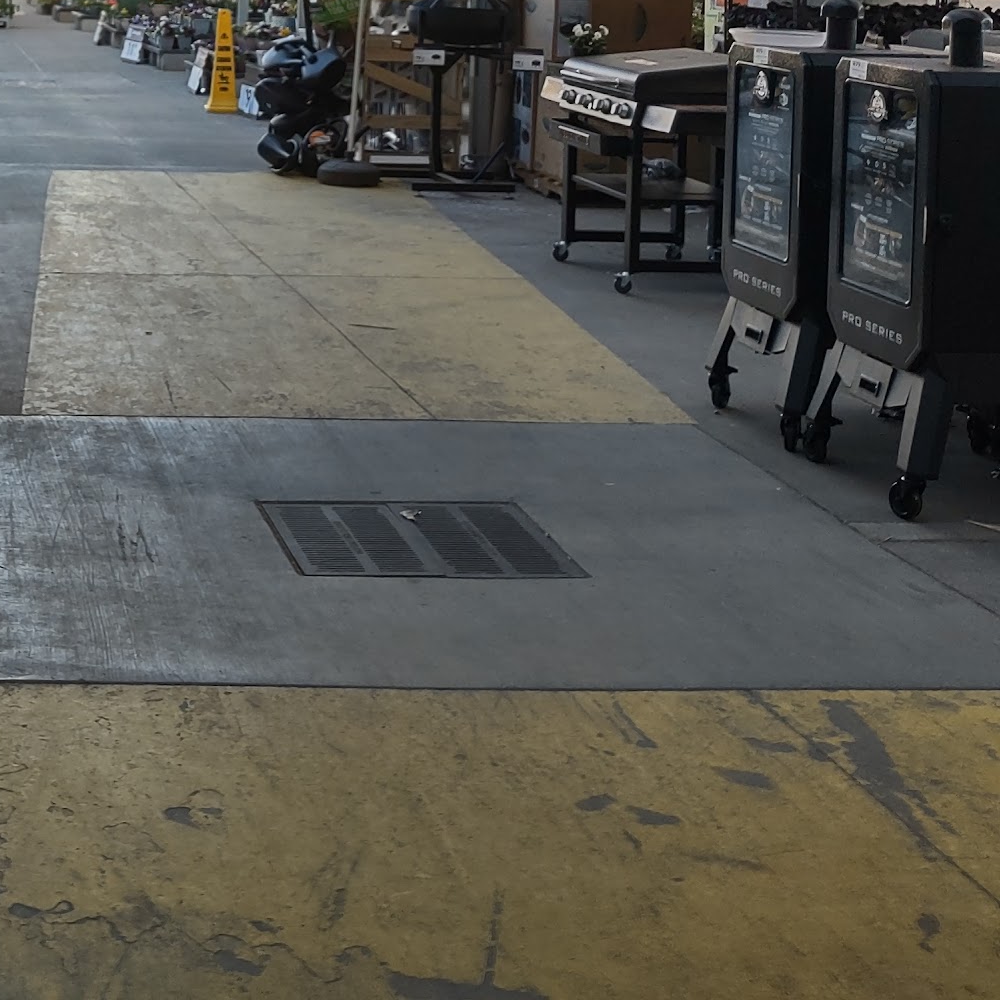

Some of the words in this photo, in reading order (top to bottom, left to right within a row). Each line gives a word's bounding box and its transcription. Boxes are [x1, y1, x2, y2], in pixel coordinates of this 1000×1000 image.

[732, 269, 749, 284] PRO
[751, 272, 782, 298] SERIES
[842, 310, 862, 328] PRO
[865, 319, 903, 345] SERIES
